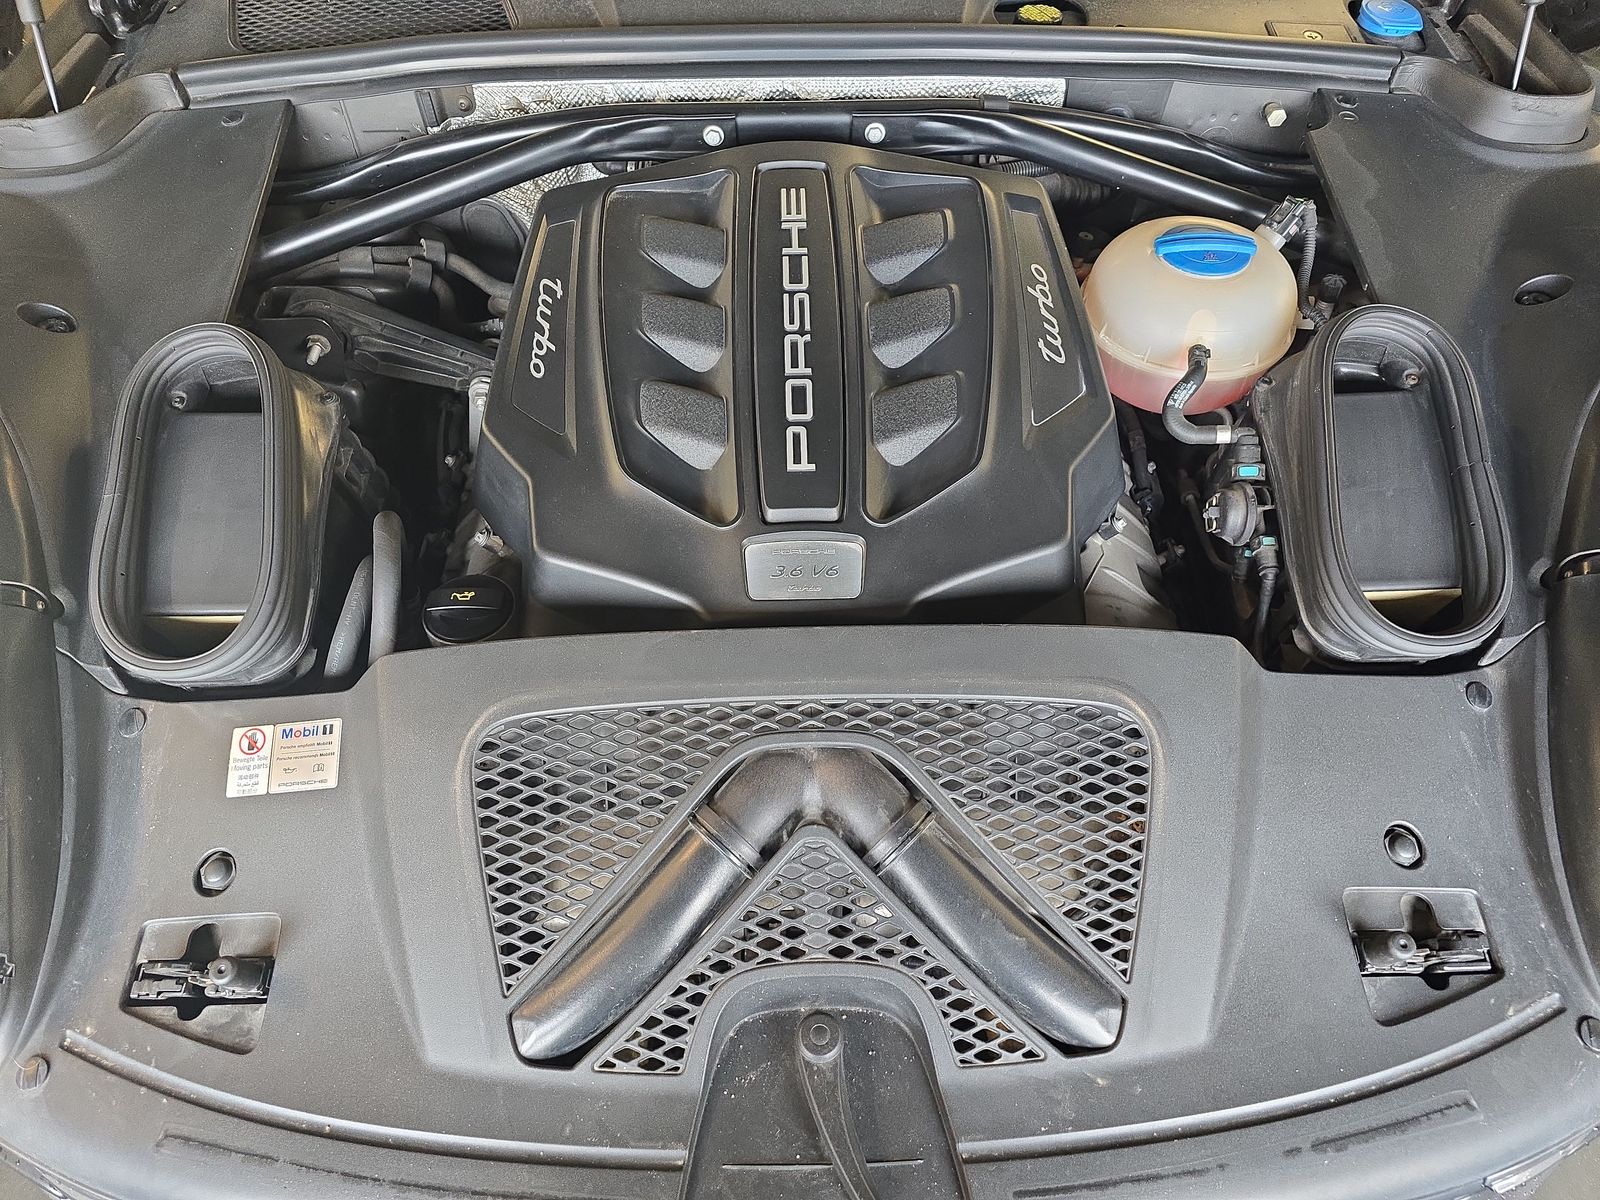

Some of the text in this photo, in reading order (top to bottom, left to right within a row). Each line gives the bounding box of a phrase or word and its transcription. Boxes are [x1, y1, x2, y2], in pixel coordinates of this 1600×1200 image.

[529, 278, 563, 379] turbo
[781, 188, 816, 472] PORSCHE
[1027, 263, 1066, 364] turbo
[769, 565, 840, 578] 3.6 V6
[281, 724, 334, 739] Mobil 1
